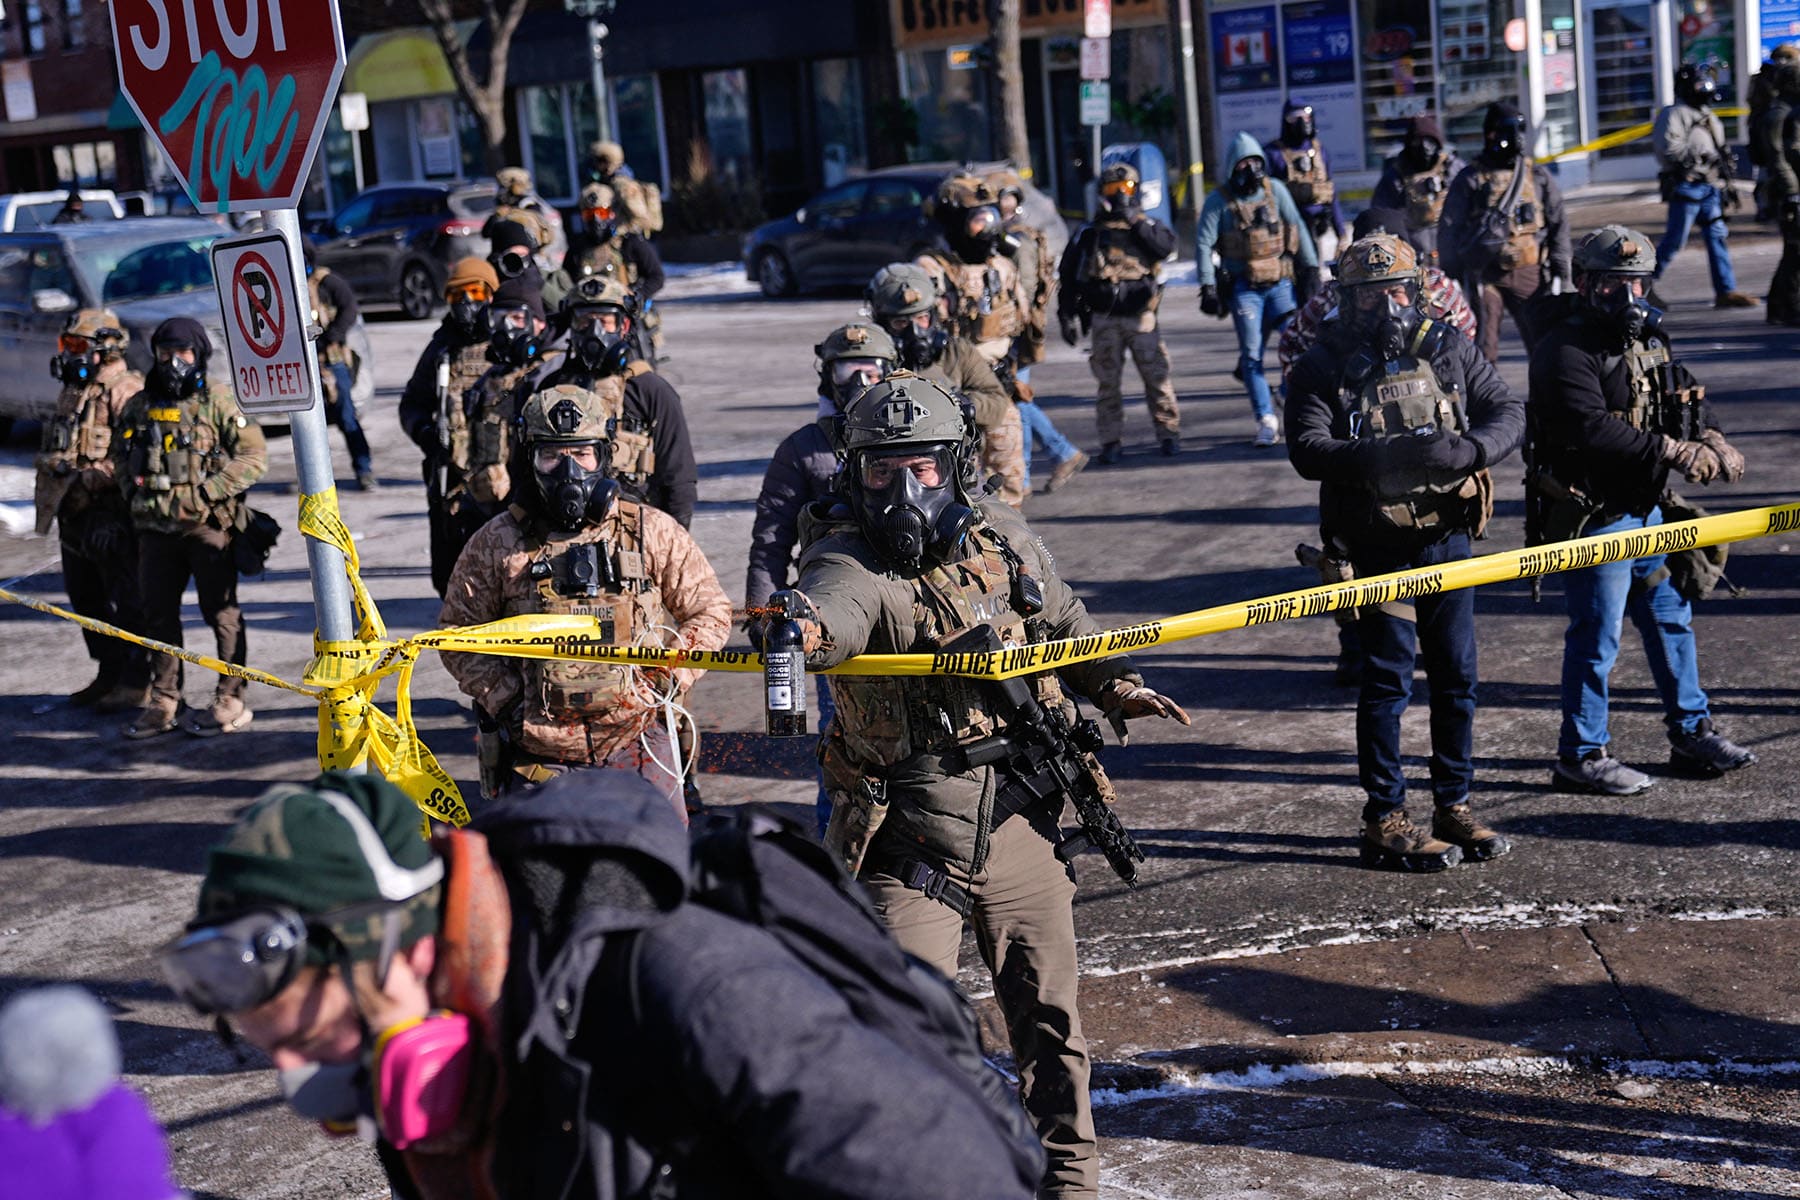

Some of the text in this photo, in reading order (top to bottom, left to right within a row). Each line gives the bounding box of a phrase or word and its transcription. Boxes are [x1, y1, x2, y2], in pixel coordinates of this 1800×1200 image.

[240, 362, 303, 398] 30 FEET
[1765, 508, 1800, 534] POLI
[1518, 526, 1698, 577] POLICE LINE DO NOT CROSS
[1246, 570, 1442, 626] POLICE LINE DO NOT CROSS
[554, 644, 620, 658] POLICE
[627, 647, 670, 660] LINE
[678, 649, 704, 662] DO
[711, 651, 750, 665] NOT
[932, 622, 1163, 675] POLICE LINE DO NOT CROSS
